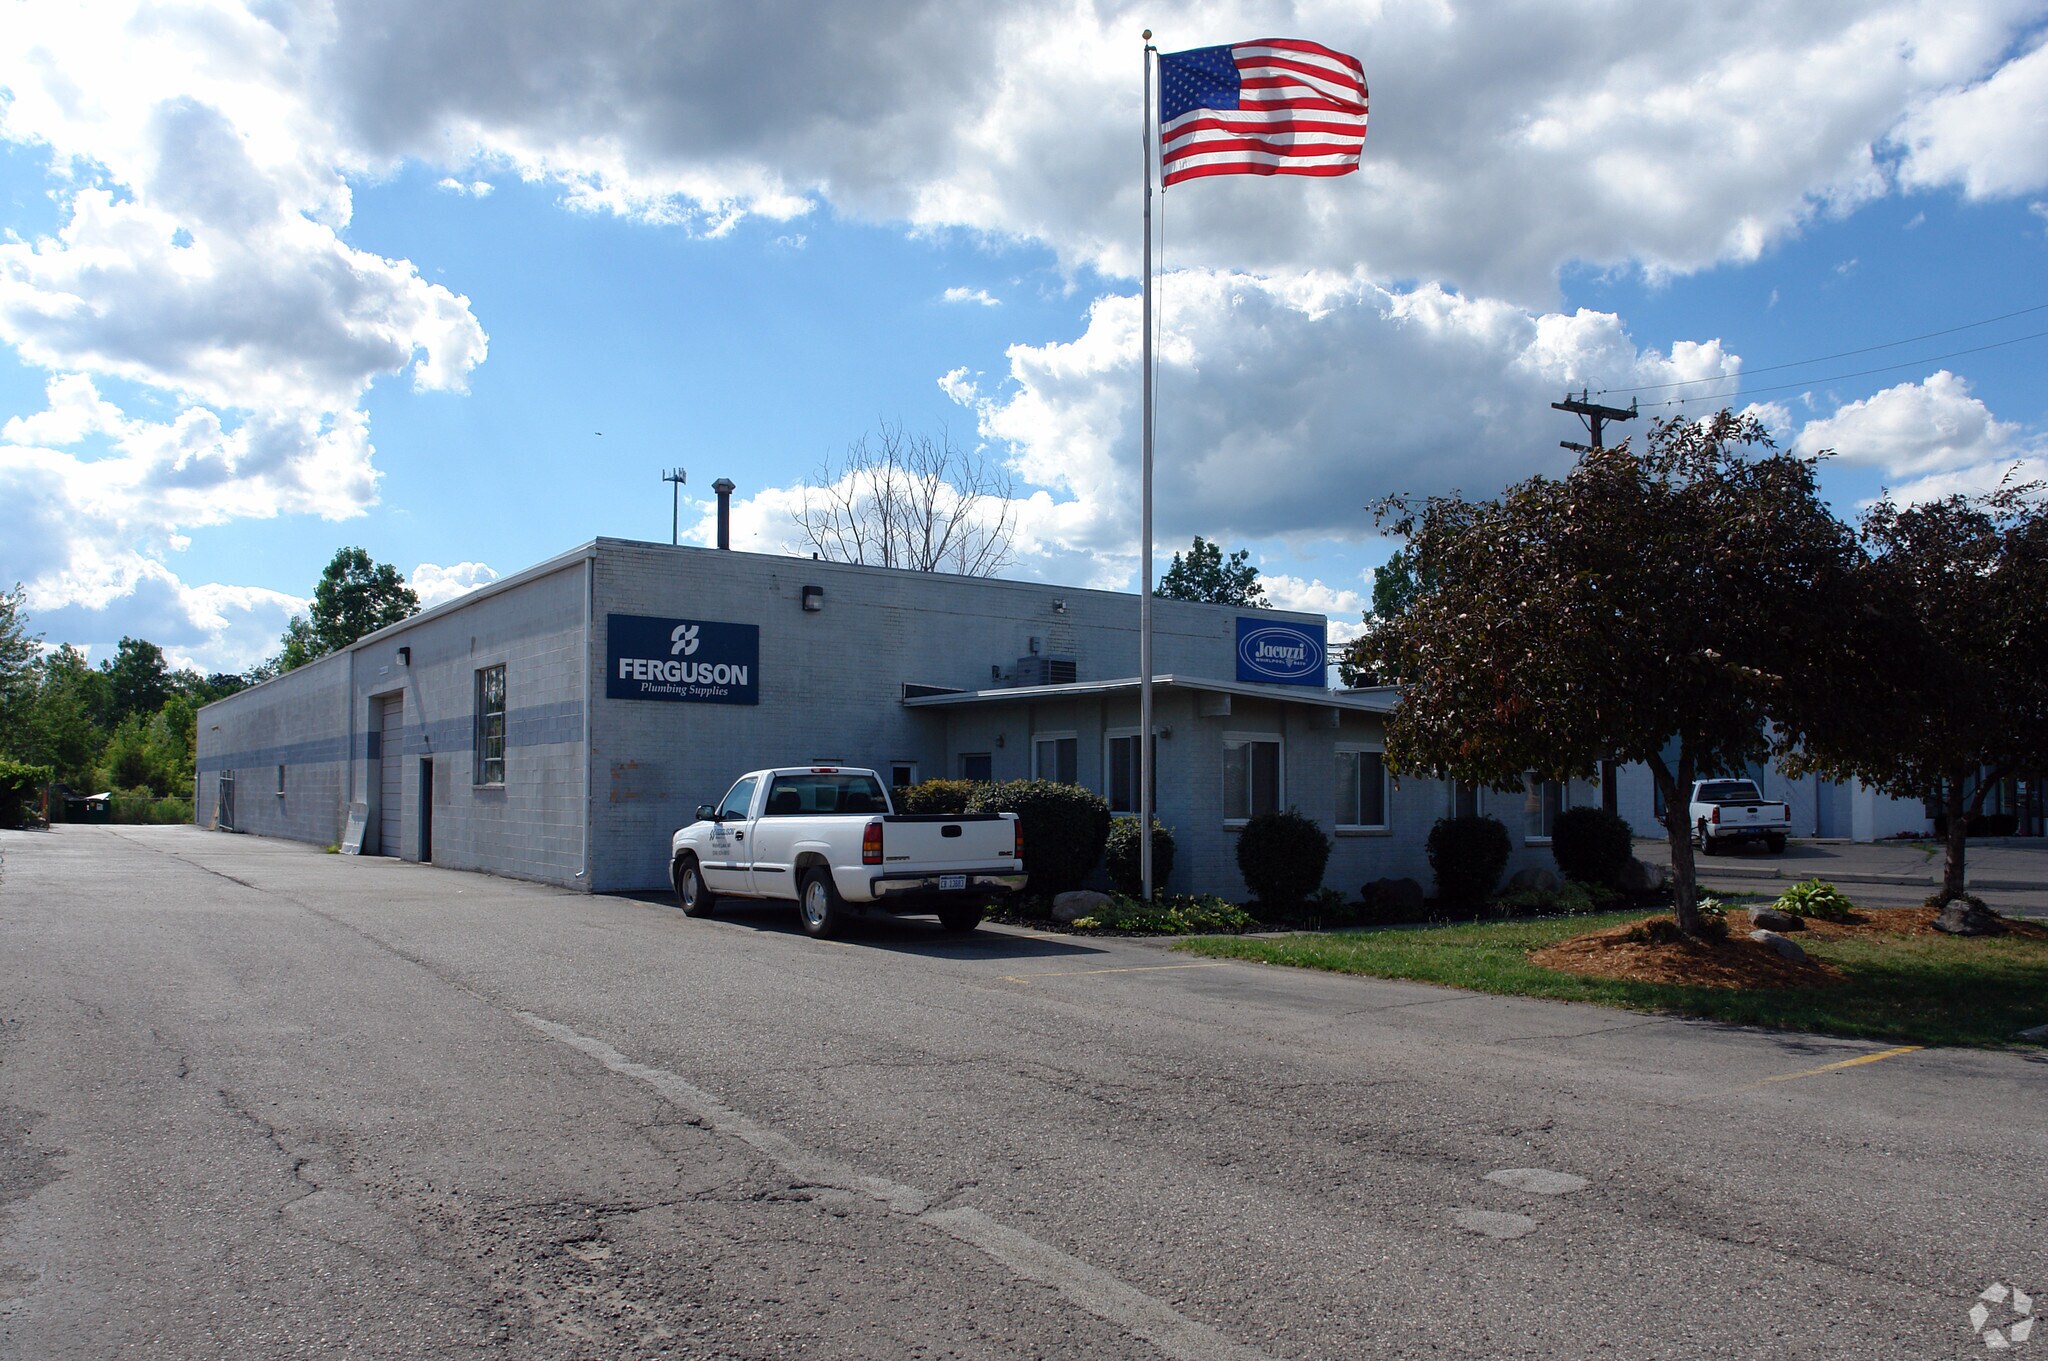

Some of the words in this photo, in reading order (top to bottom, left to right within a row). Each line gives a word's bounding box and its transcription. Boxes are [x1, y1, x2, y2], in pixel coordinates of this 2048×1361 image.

[1255, 641, 1304, 659] Jacuzzi
[619, 658, 748, 685] FERGUSON
[641, 682, 687, 696] Plumbing
[689, 684, 728, 698] Supplies
